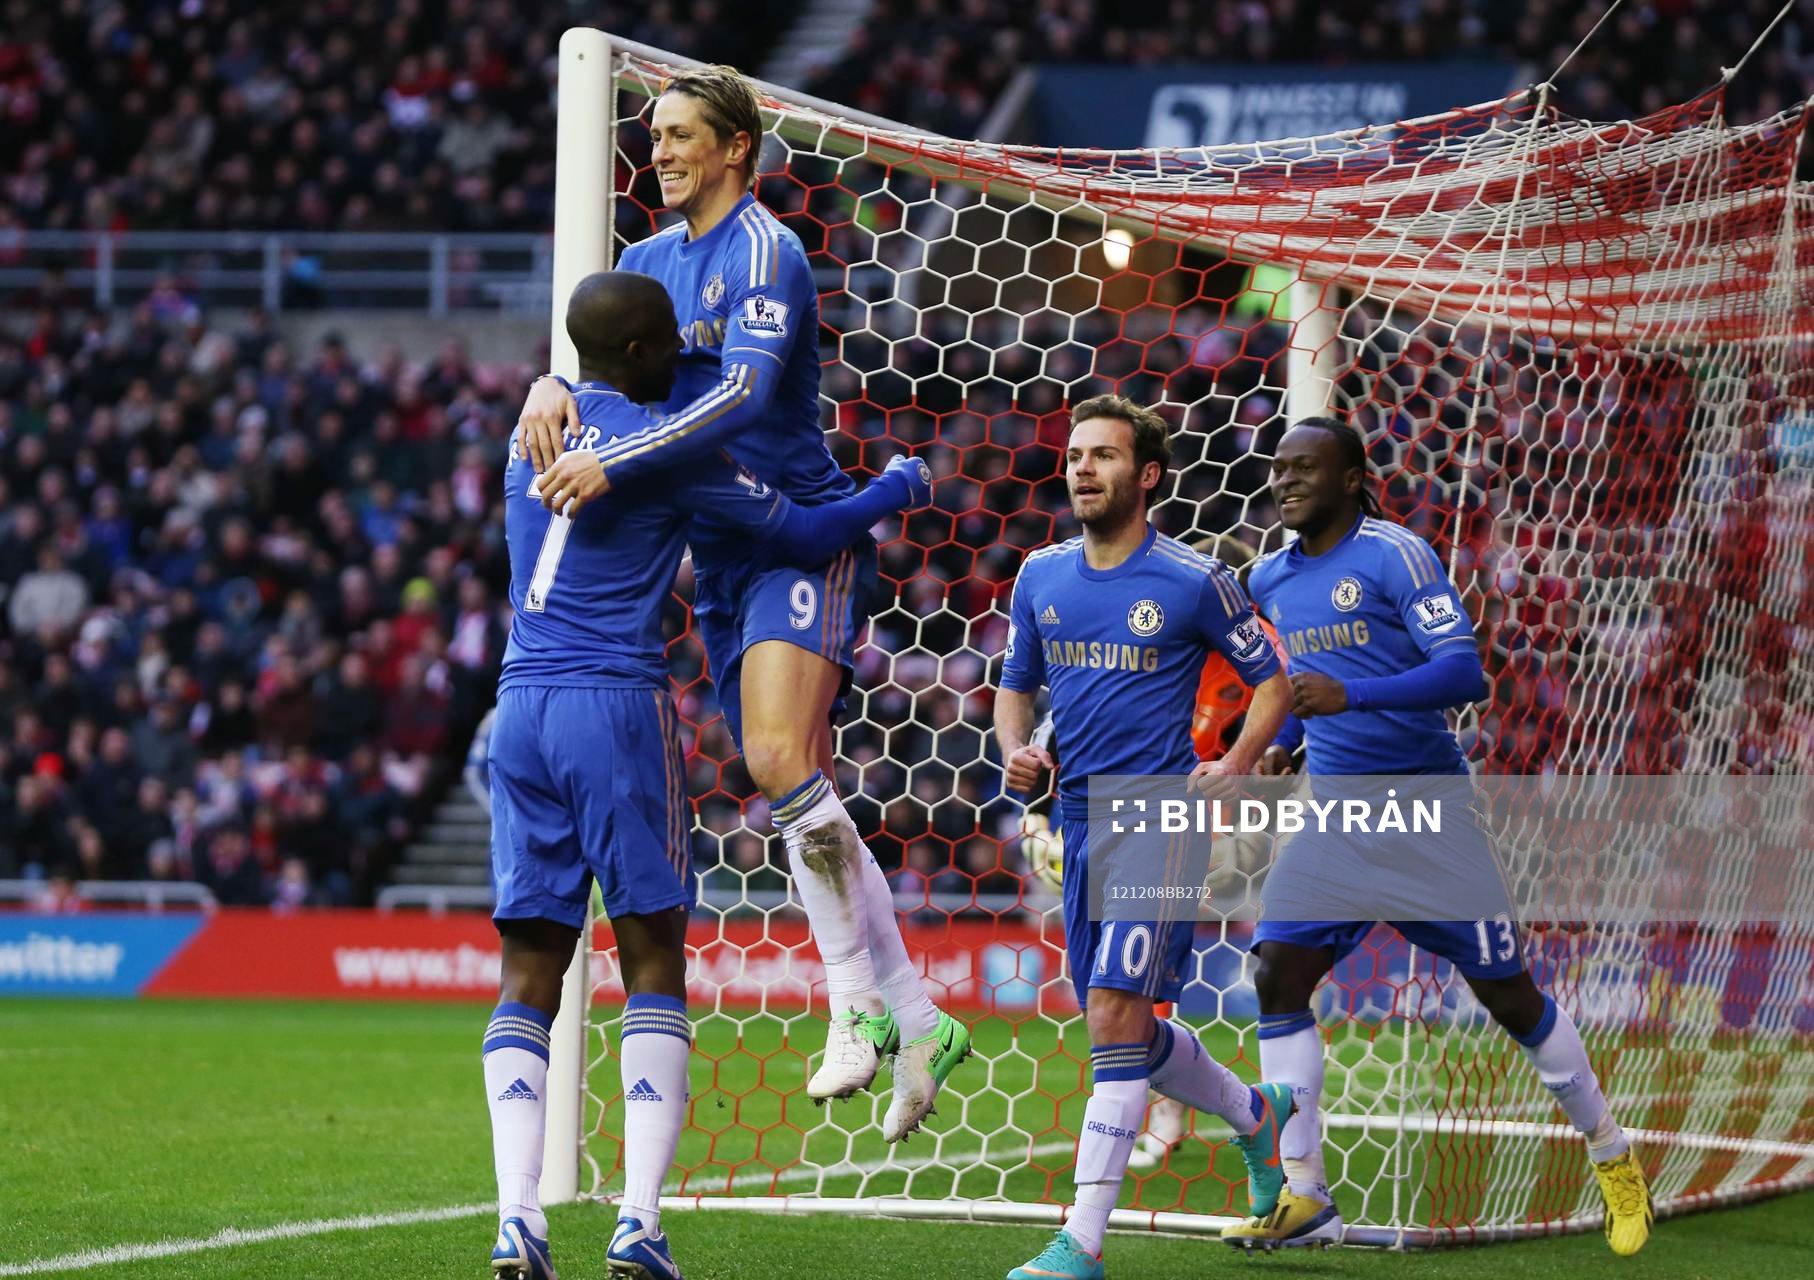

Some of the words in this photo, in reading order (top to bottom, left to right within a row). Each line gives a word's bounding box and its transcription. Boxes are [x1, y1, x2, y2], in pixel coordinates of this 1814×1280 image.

[525, 472, 576, 613] 7
[789, 579, 817, 631] 9
[1042, 638, 1159, 672] SAMSUNG
[0, 932, 124, 981] witter
[1097, 921, 1153, 979] 10
[1474, 912, 1516, 965] 13
[497, 1091, 538, 1102] adidas
[626, 1092, 663, 1102] adidas
[1087, 1120, 1126, 1138] CHELSEA
